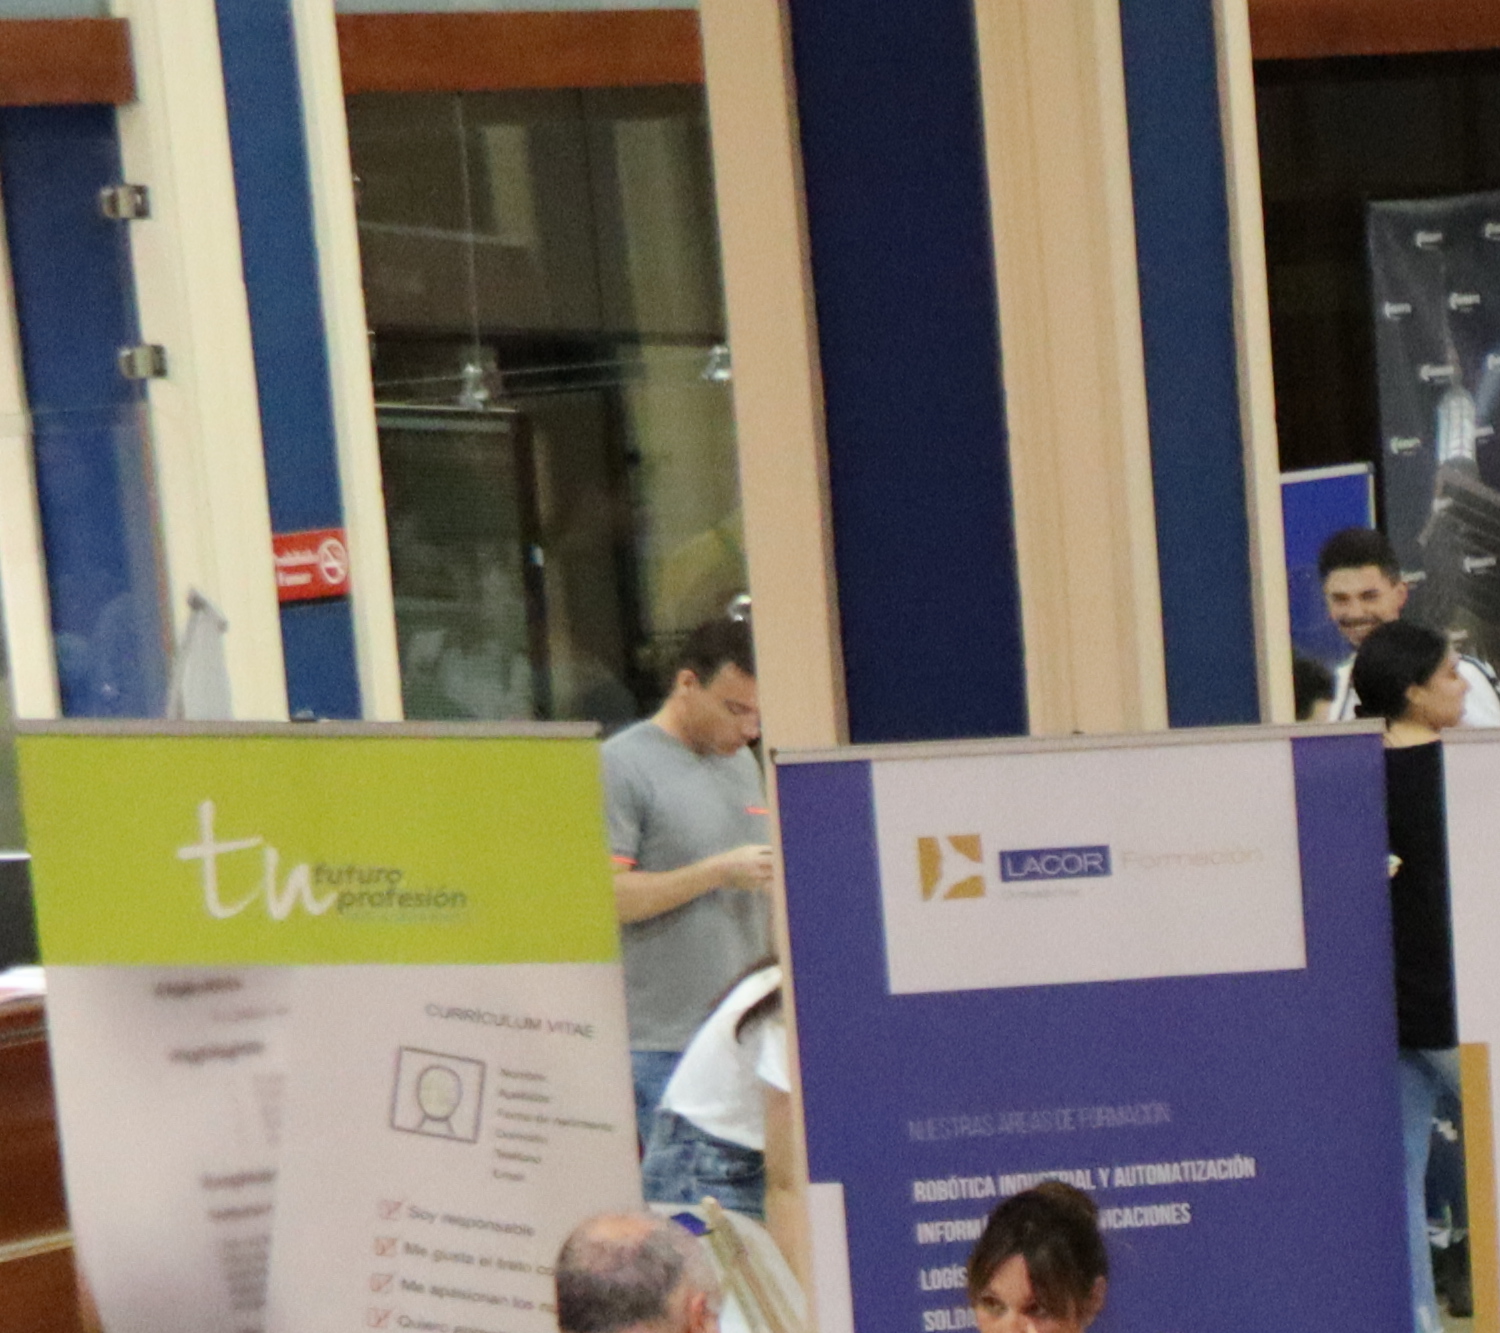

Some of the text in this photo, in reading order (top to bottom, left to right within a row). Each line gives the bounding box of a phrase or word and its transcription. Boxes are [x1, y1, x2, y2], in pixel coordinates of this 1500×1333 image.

[176, 799, 338, 920] tu
[1006, 854, 1104, 876] LACOR
[314, 863, 402, 884] futuro
[914, 1174, 996, 1202] ROBÓTICA
[1099, 1168, 1111, 1188] Y
[1115, 1154, 1256, 1188] AUTOMATIZACIÓN
[920, 1265, 969, 1291] LOGÍS
[923, 1308, 979, 1332] SOLDA
